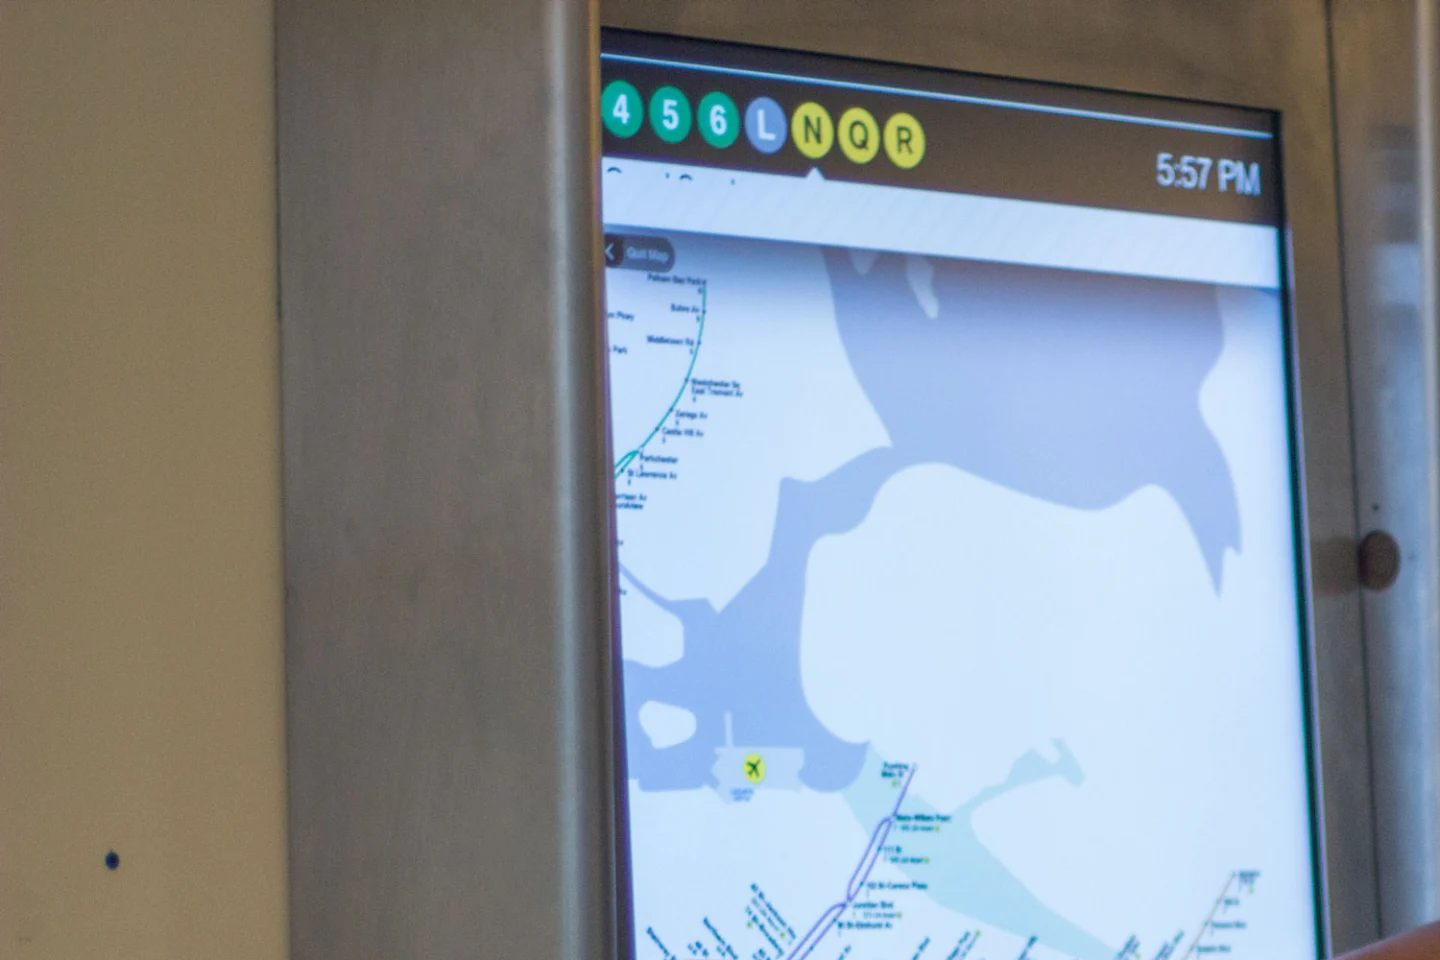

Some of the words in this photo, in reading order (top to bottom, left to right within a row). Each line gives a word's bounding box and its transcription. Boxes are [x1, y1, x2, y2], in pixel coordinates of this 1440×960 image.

[612, 94, 630, 124] 4
[662, 99, 679, 130] 5
[709, 104, 727, 136] 6
[757, 109, 776, 140] L
[804, 115, 822, 144] N
[849, 120, 869, 150] Q
[896, 125, 913, 154] R
[1156, 152, 1212, 190] 5:57
[1217, 158, 1261, 196] PM
